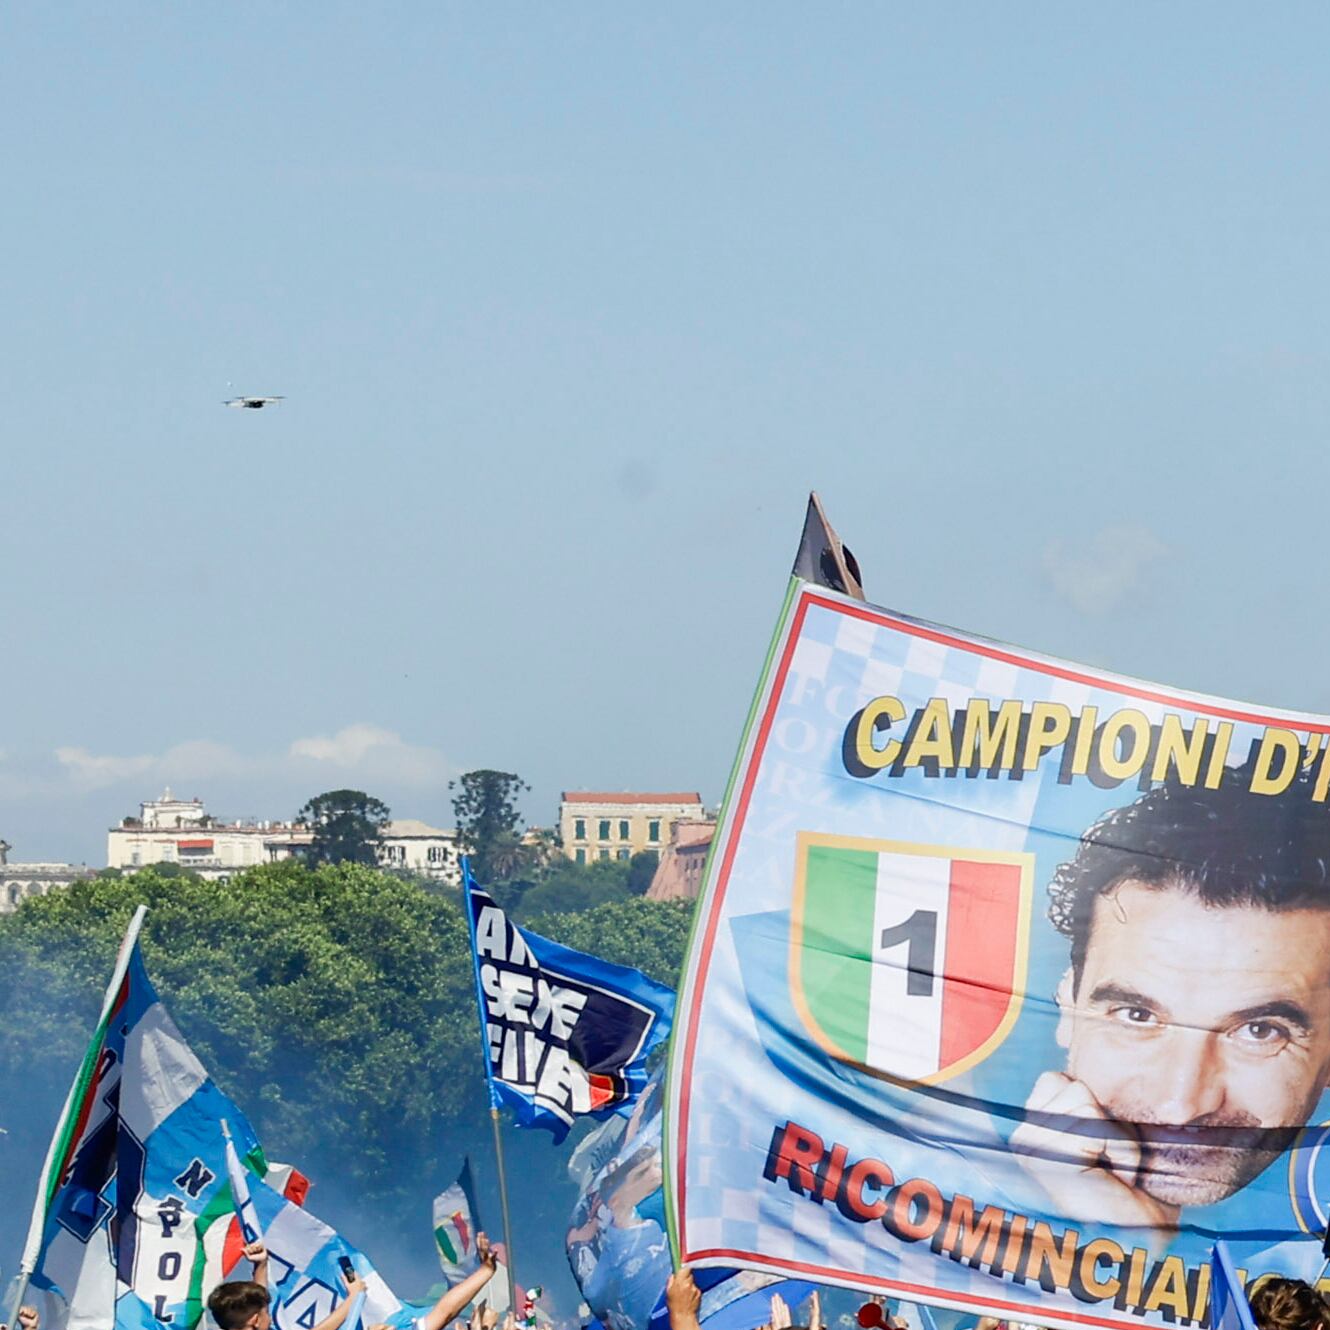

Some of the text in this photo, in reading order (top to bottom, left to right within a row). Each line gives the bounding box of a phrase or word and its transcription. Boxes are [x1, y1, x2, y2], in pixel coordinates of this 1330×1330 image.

[846, 695, 1235, 794] CAMPIONI
[880, 909, 938, 997] 1
[767, 1119, 1283, 1329] RICOMINCIA
